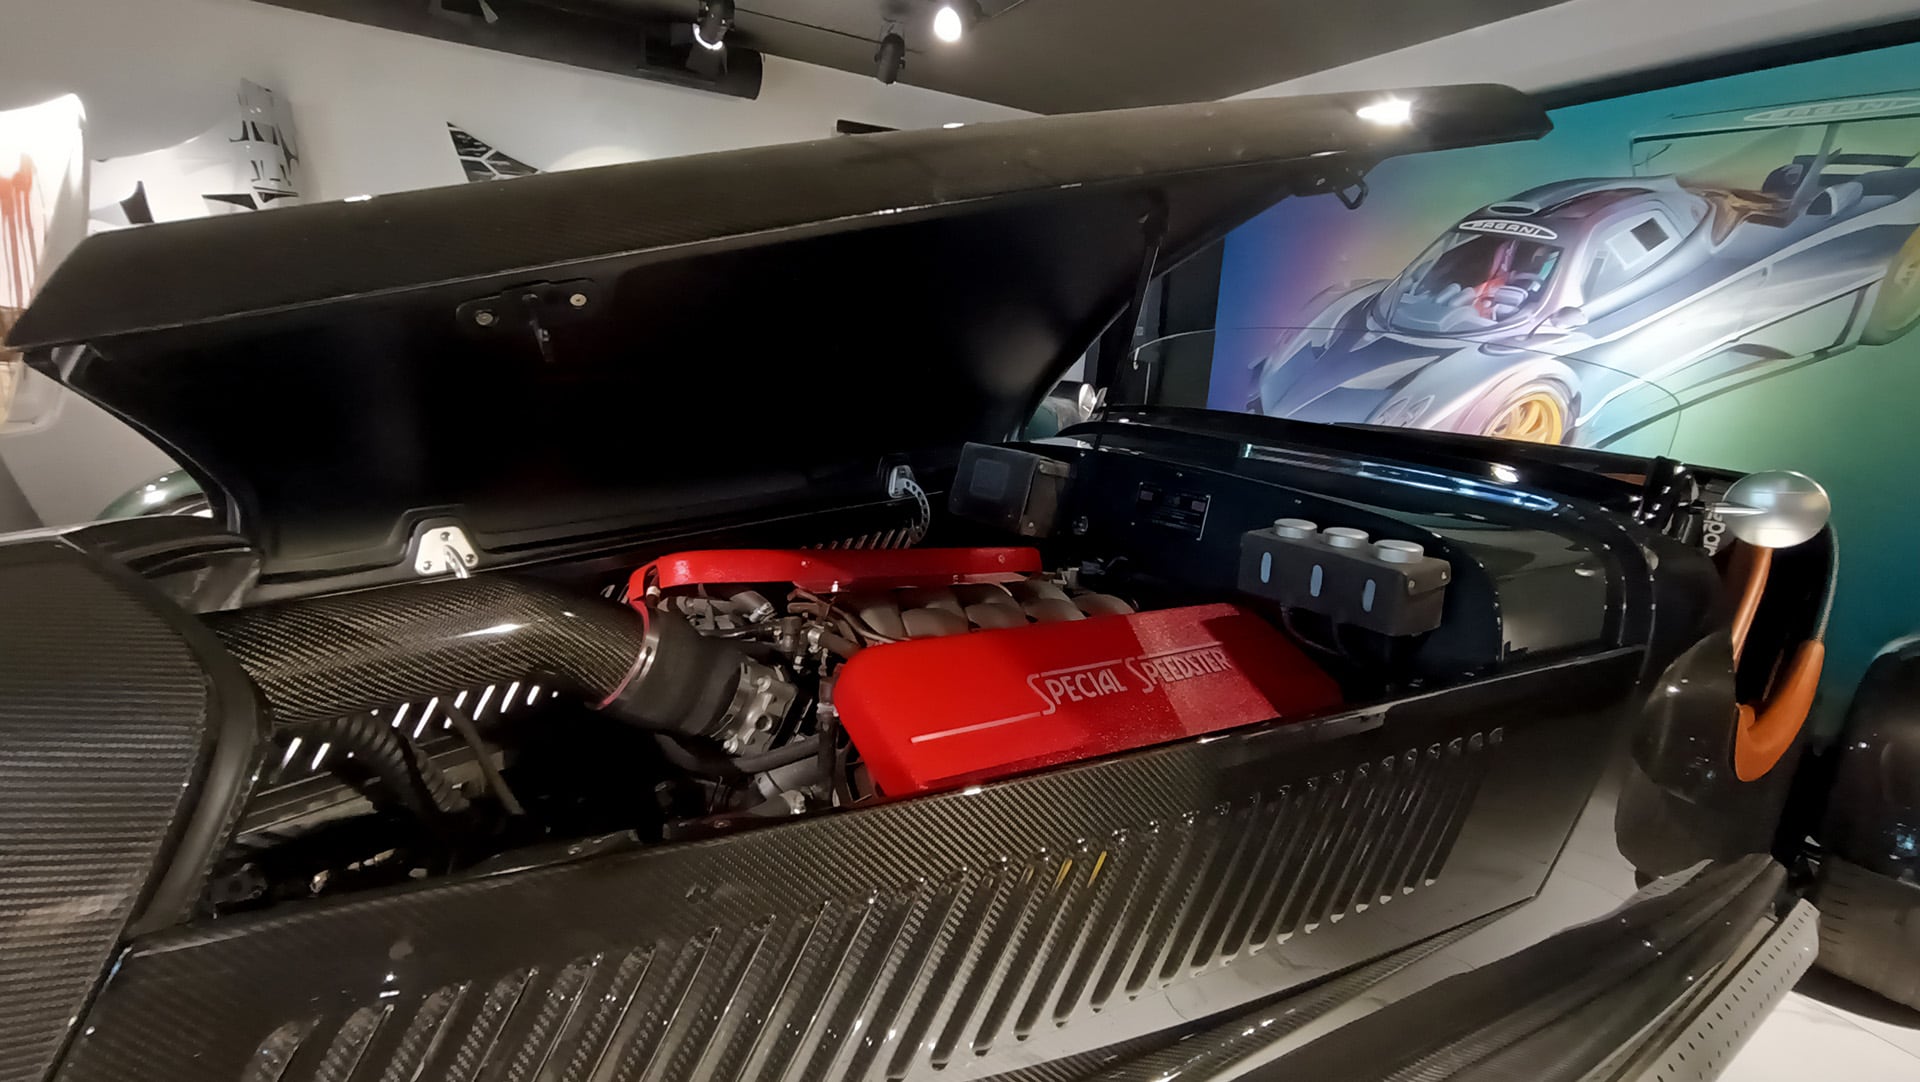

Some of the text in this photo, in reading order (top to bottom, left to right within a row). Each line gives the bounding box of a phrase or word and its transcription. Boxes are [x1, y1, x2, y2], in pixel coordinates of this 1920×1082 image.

[1471, 221, 1540, 236] PAGANI
[1026, 648, 1233, 716] SPECIAL SPEEDSTER
